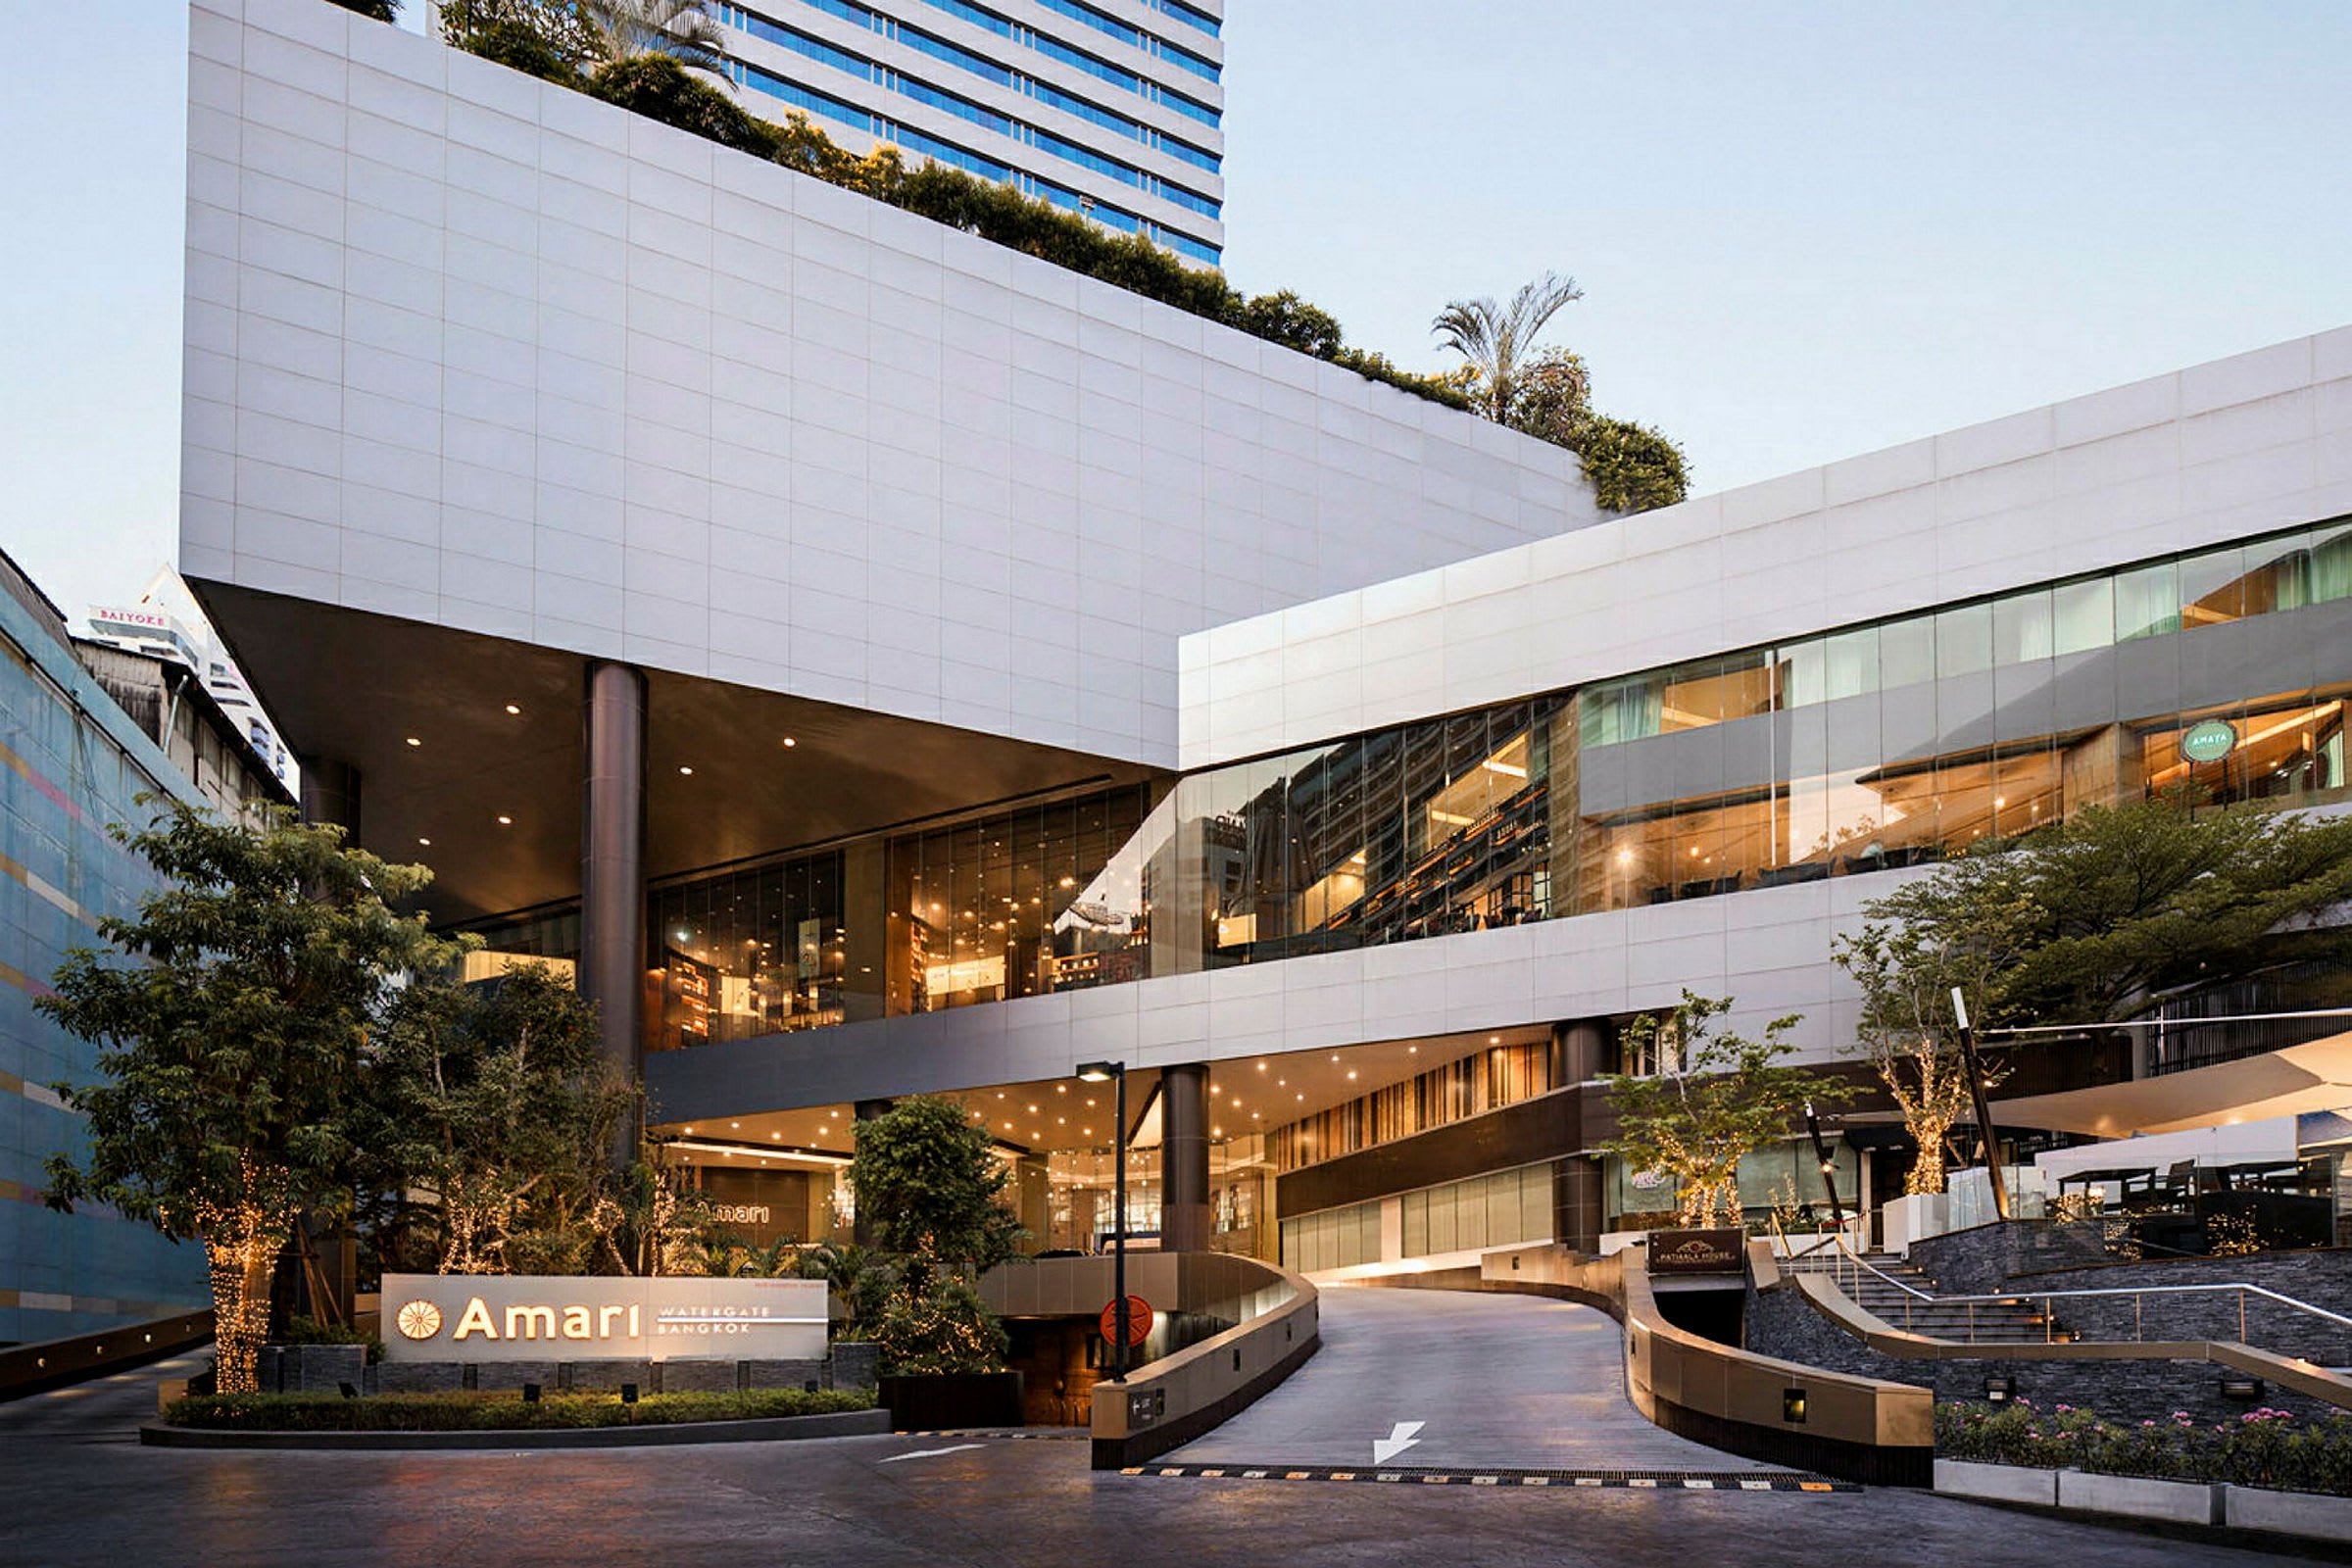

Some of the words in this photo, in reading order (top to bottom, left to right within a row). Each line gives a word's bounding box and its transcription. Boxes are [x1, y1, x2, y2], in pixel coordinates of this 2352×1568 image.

[100, 610, 166, 626] BAIYOKE
[453, 1296, 640, 1340] Amari
[660, 1306, 770, 1317] WATERGATE
[658, 1323, 751, 1335] BANGKOK
